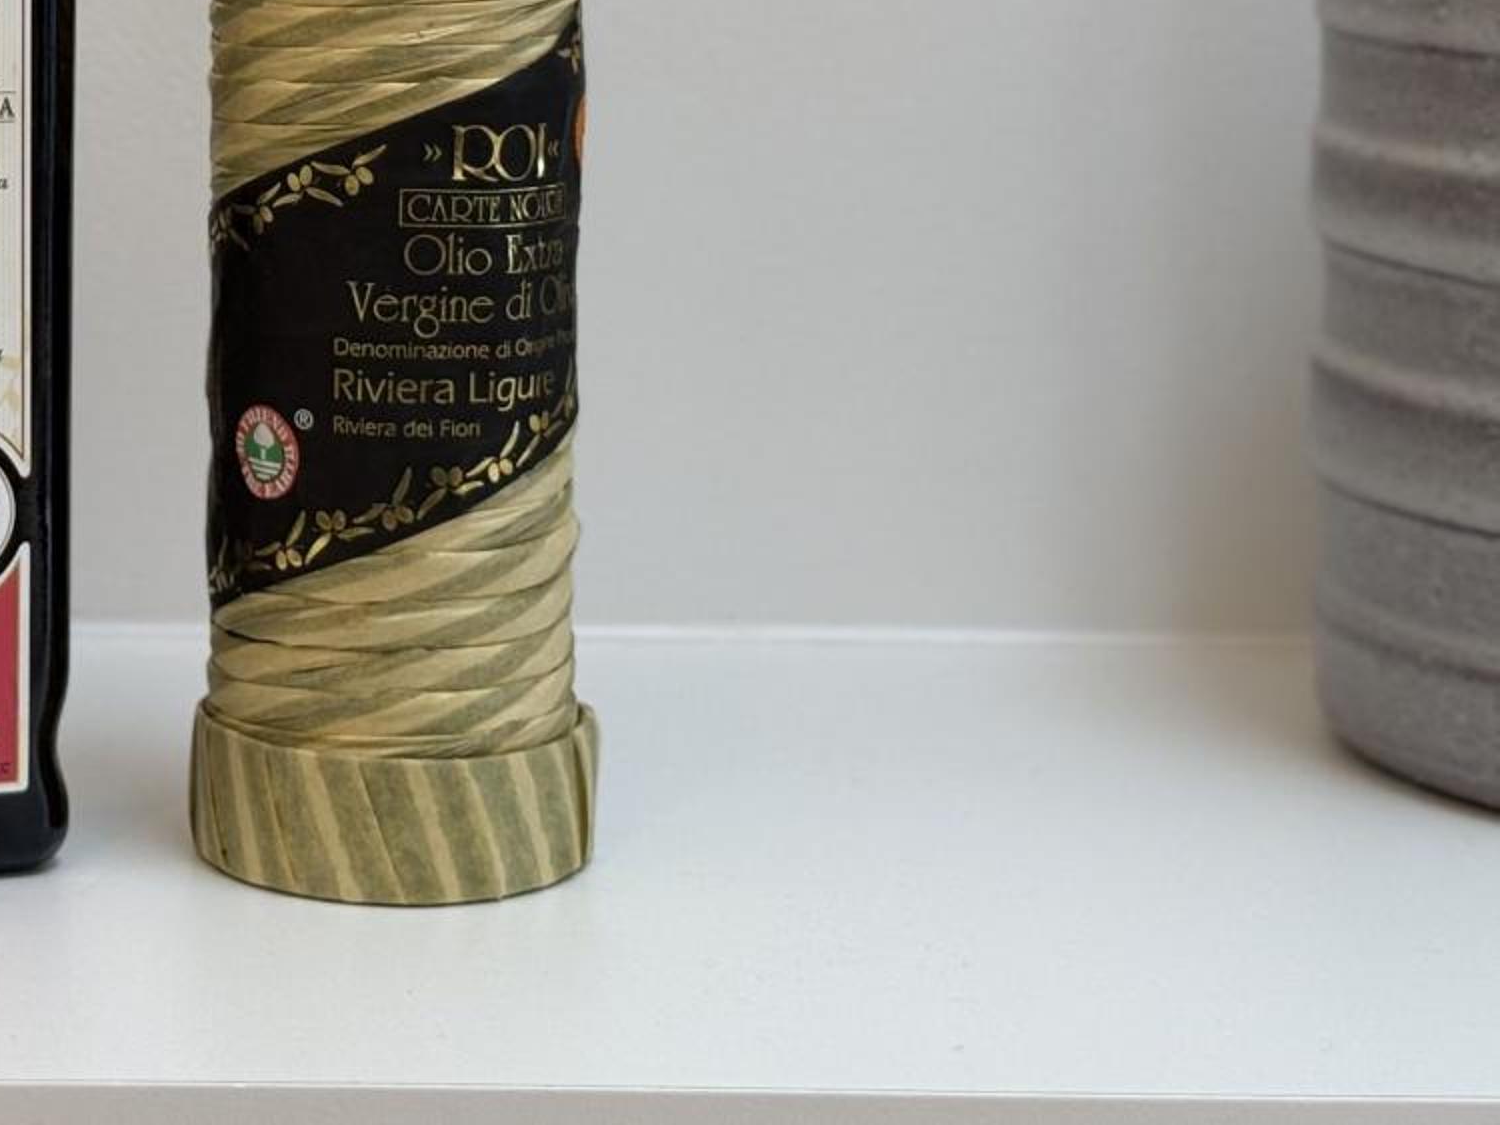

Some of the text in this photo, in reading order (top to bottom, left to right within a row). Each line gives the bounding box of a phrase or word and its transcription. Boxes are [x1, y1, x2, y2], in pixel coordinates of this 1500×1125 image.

[407, 194, 501, 224] CARTE
[403, 232, 493, 276] Olio
[346, 280, 496, 339] Vergine
[505, 279, 533, 321] di
[333, 337, 490, 360] Denominazione
[495, 339, 512, 359] di
[333, 367, 455, 405] Riviera
[333, 415, 481, 438] Riviera dei Fiori
